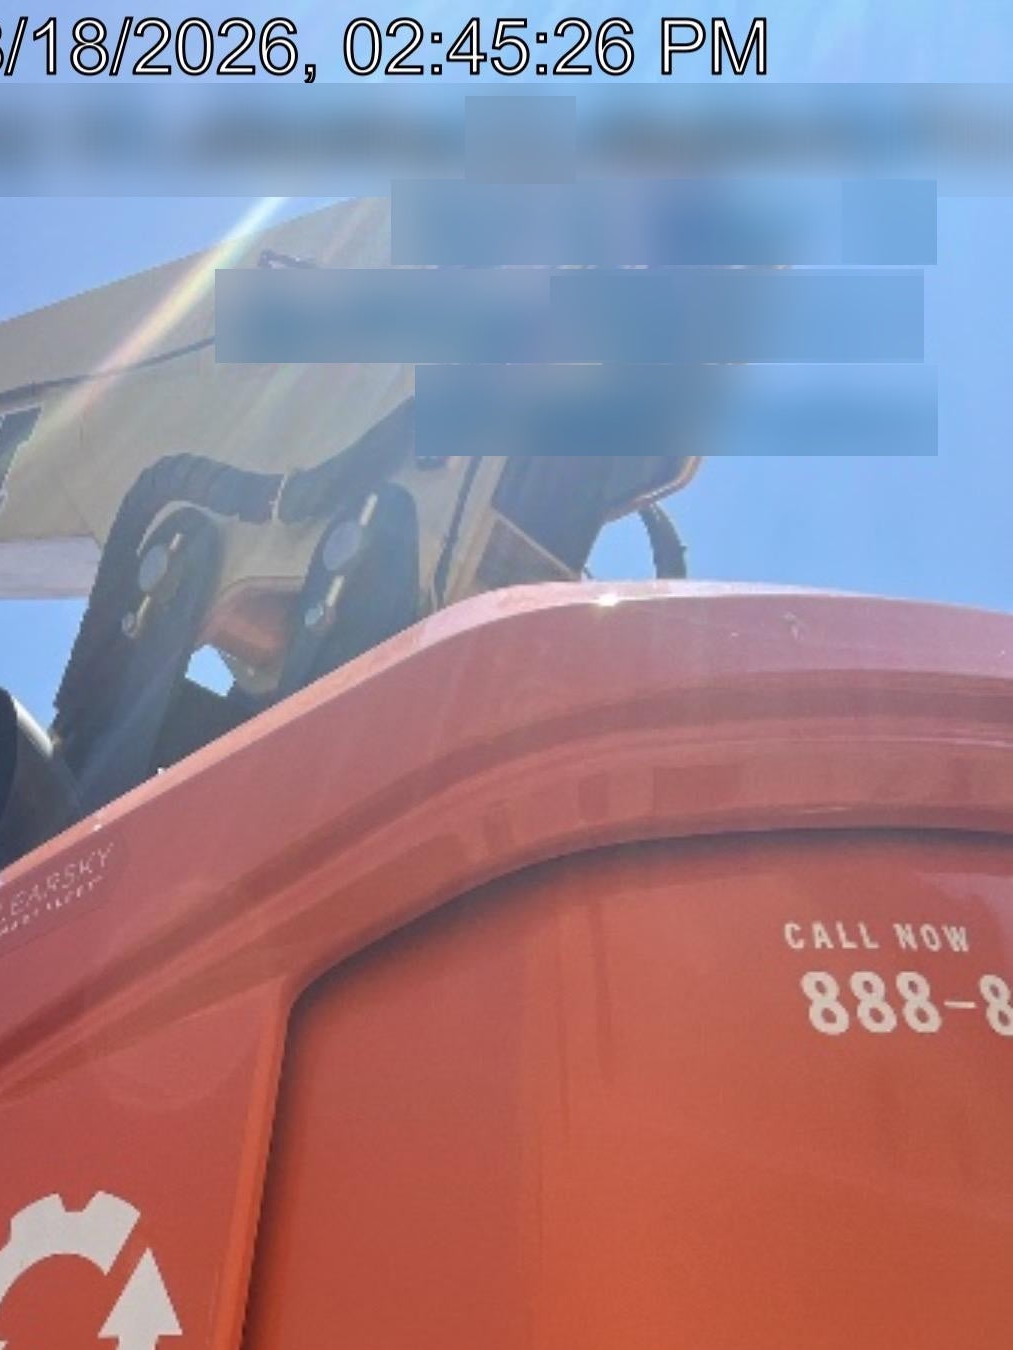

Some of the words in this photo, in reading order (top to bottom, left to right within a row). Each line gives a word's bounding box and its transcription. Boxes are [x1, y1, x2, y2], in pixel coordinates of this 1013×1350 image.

[783, 920, 880, 950] CALL
[893, 922, 970, 953] NOW
[799, 970, 1013, 1036] 888-8
